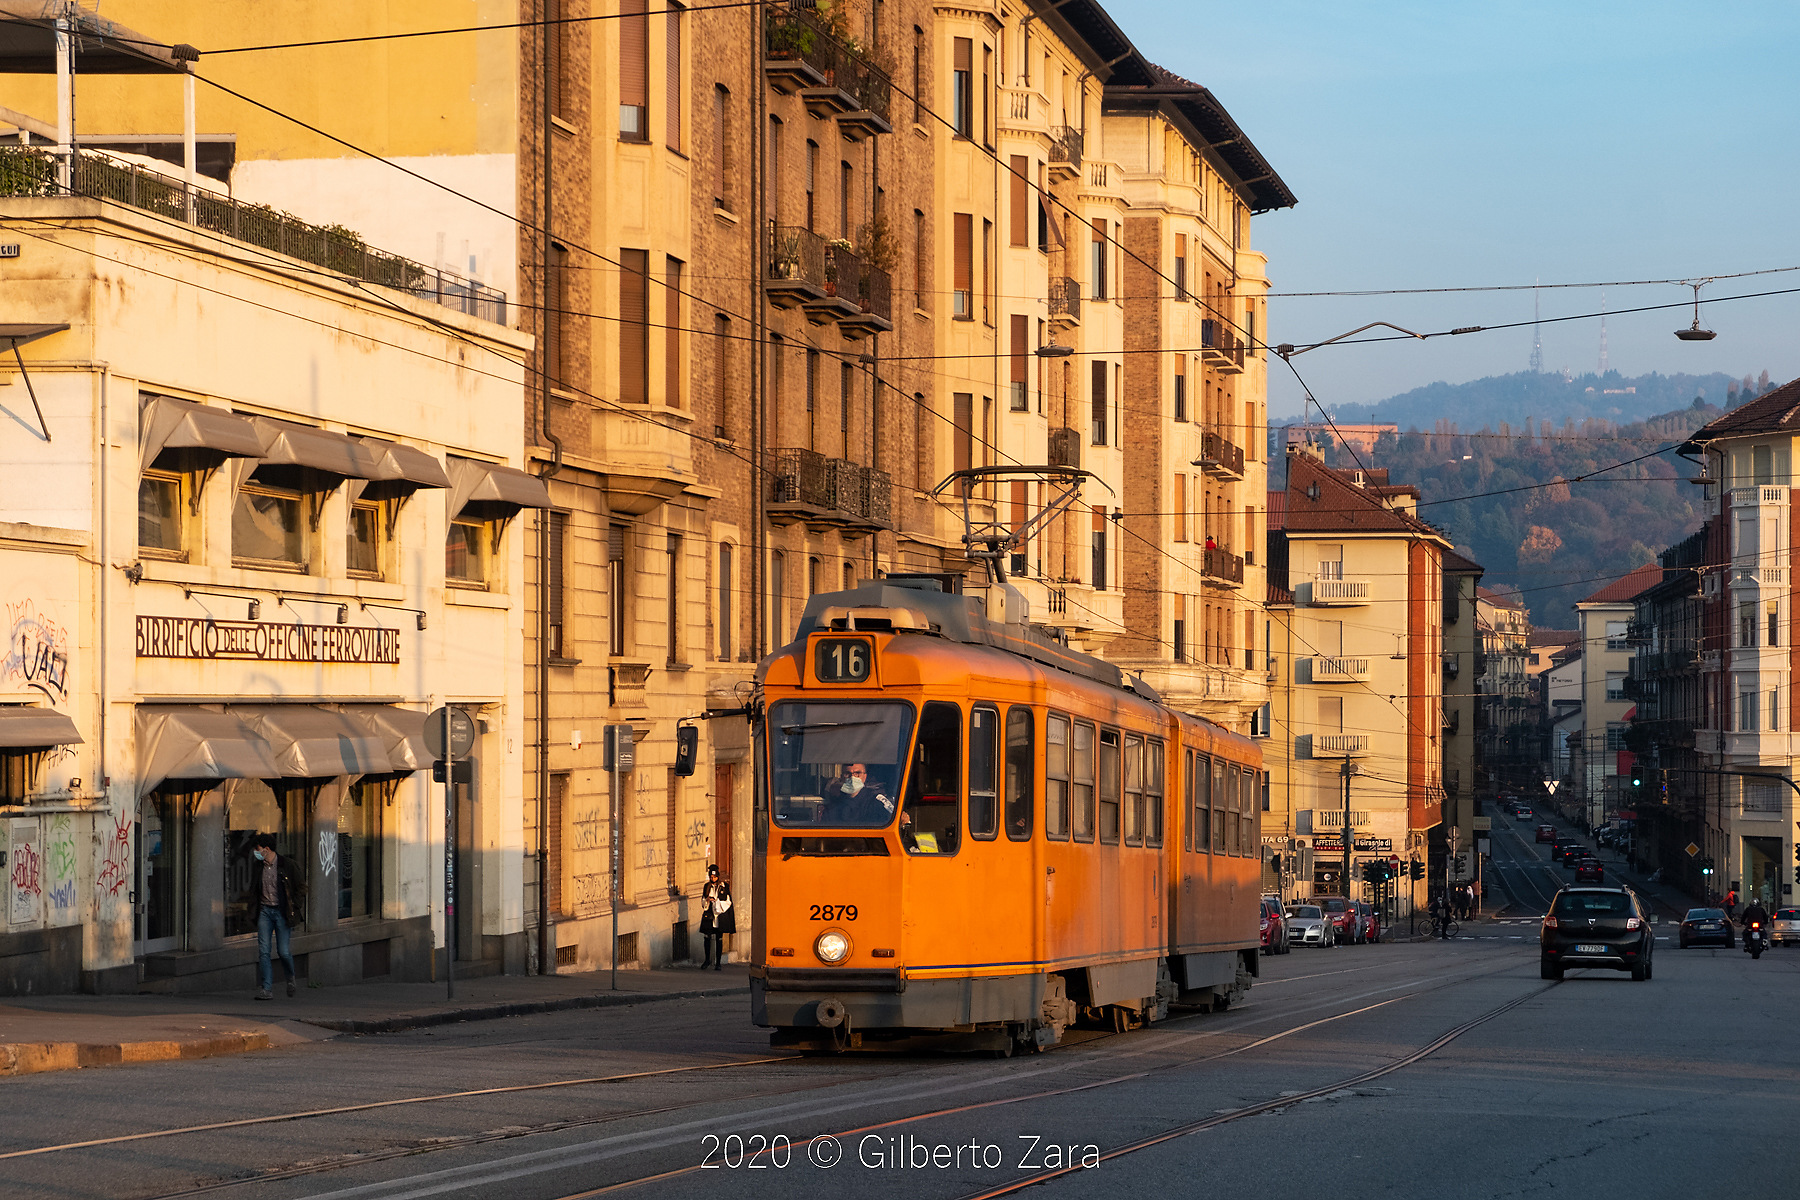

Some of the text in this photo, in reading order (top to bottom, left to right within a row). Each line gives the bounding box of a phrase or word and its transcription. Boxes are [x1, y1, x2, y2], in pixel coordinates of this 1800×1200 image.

[136, 616, 400, 664] BIRRIFICIO DELLE OFFICINE FERROVIARIE
[831, 644, 865, 678] 16
[809, 904, 858, 922] 2879
